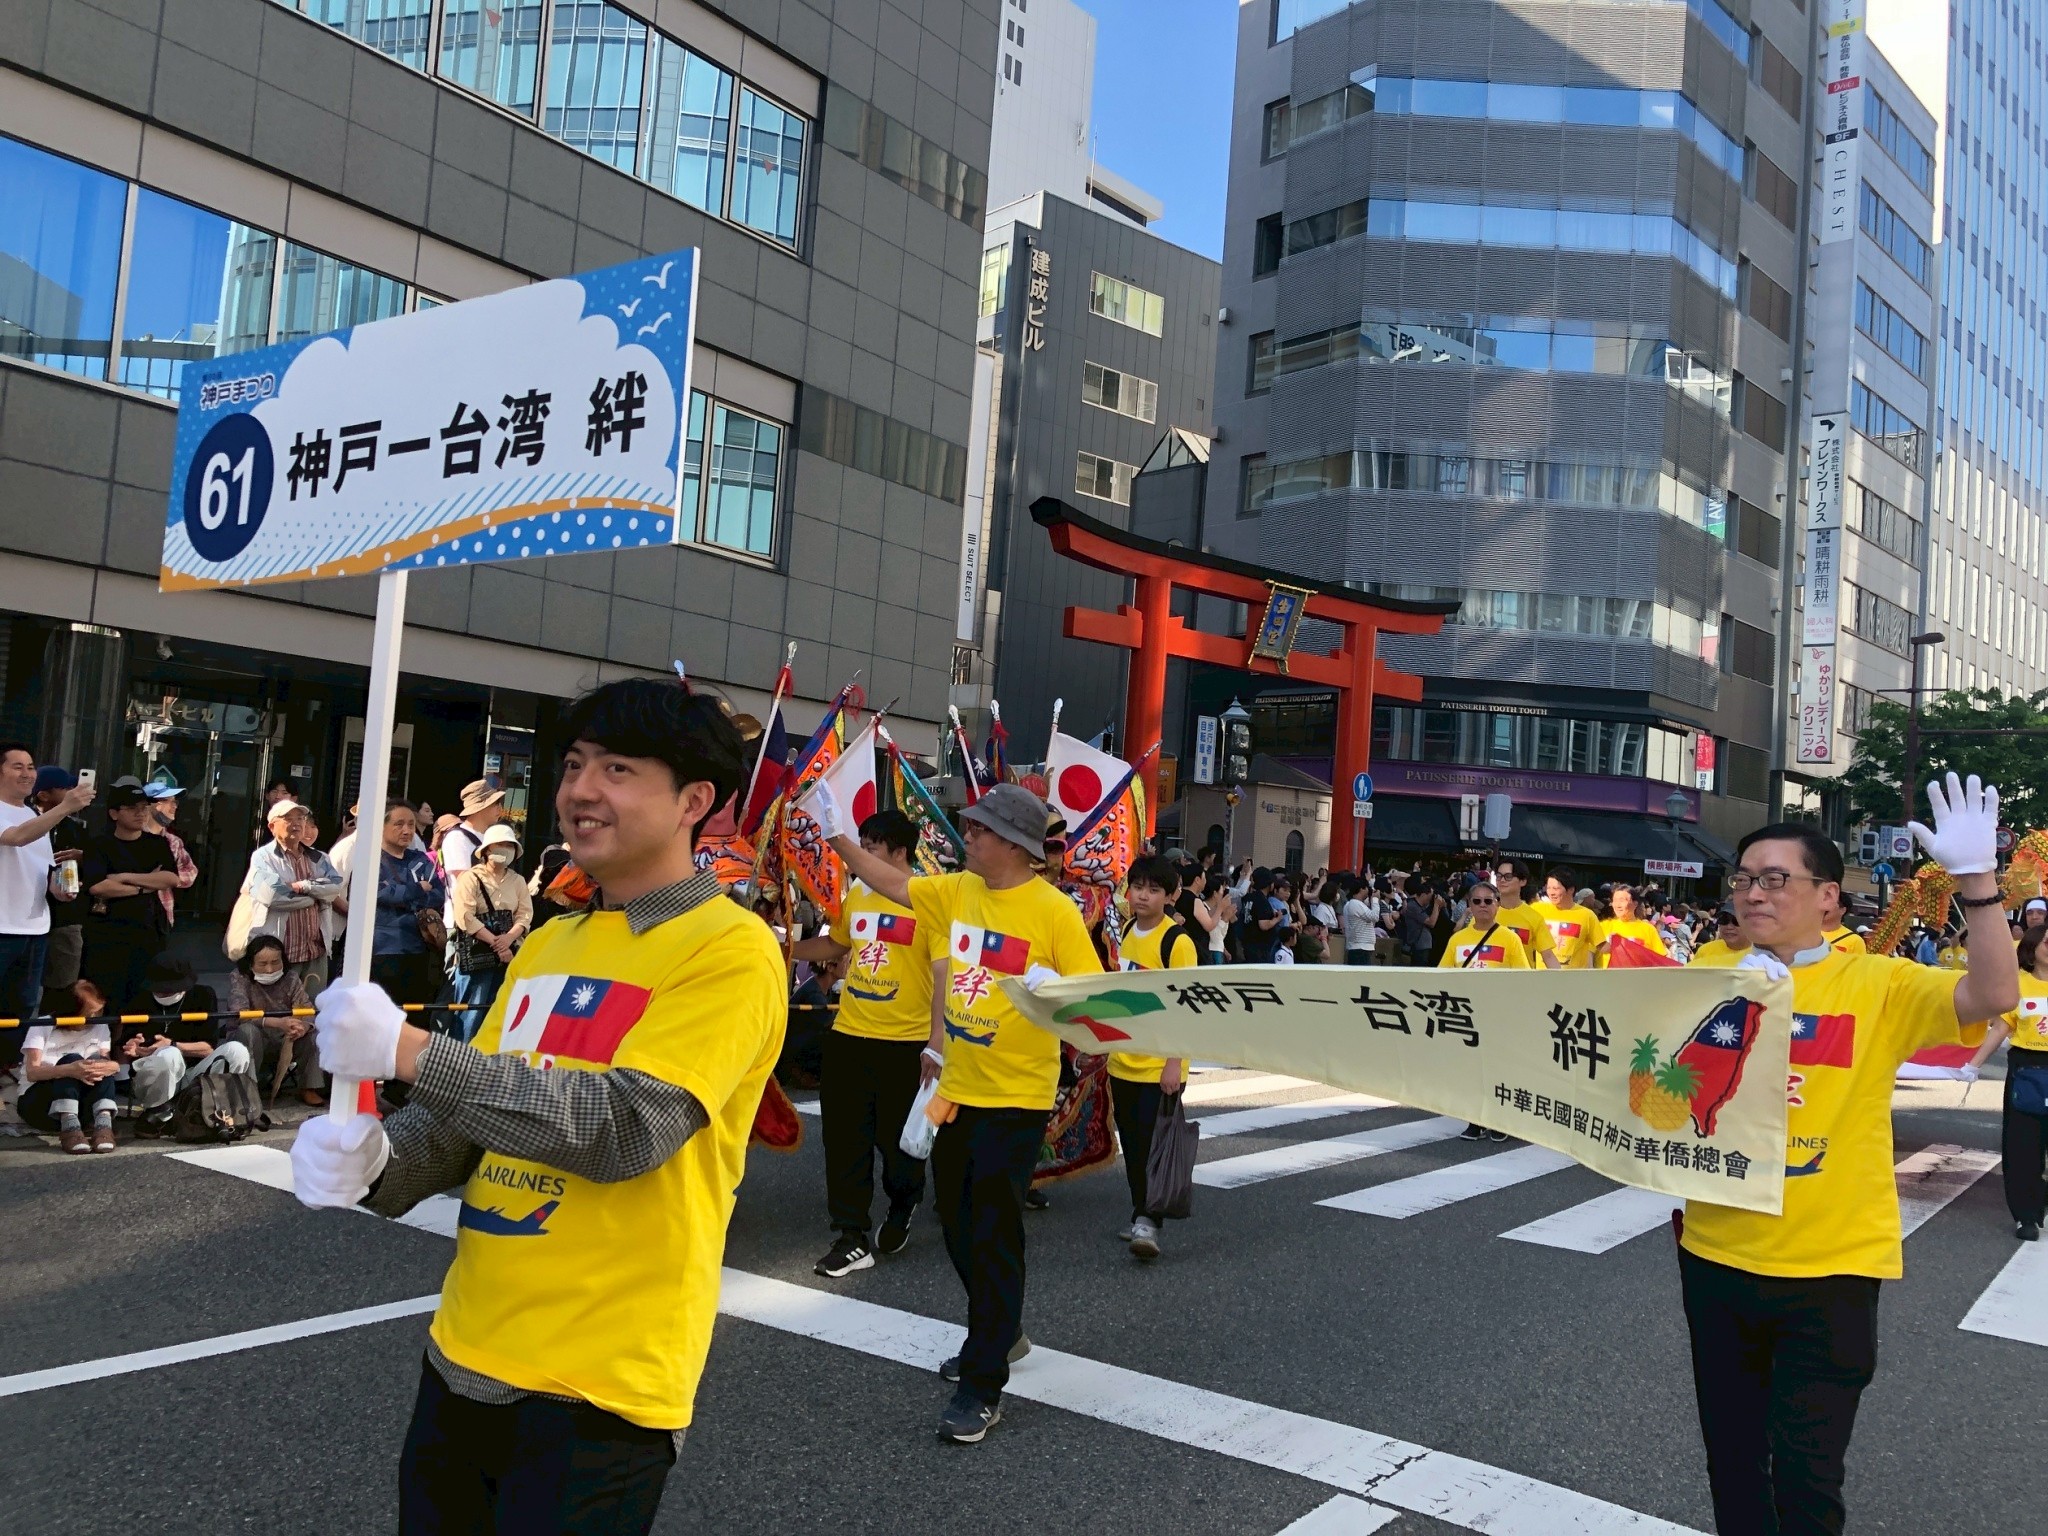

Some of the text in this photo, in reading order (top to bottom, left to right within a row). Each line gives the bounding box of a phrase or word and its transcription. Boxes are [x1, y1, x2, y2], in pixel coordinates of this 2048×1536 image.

[1834, 132, 1850, 142] 9F
[1831, 149, 1848, 231] CHEST
[1025, 248, 1051, 352] 建成ビル
[200, 372, 274, 411] 神戸まつり
[585, 370, 649, 459] 絆
[1830, 438, 1841, 472] 株式会社
[198, 446, 257, 532] 61
[1815, 438, 1831, 523] ブレインワークス
[964, 548, 975, 604] SUIT SELECT
[1813, 546, 1831, 604] 晴耕雨耕
[1440, 702, 1548, 715] PATISSERIE TOOTH TOOTH
[1815, 664, 1831, 745] ゆかりレディース
[1802, 705, 1815, 758] クリニック
[1406, 769, 1571, 792] PATISSERIE TOOTH TOOTH
[1499, 850, 1521, 858] TOOTH
[1522, 852, 1544, 860] TOOTH
[1647, 861, 1683, 873] 横断場所
[857, 941, 889, 975] 絆
[864, 978, 900, 988] AIRLINES
[952, 966, 994, 1009] 絆
[955, 1011, 1000, 1030] AIRLINES
[1546, 1003, 1612, 1081] 絆
[482, 1164, 567, 1197] AIRLINES
